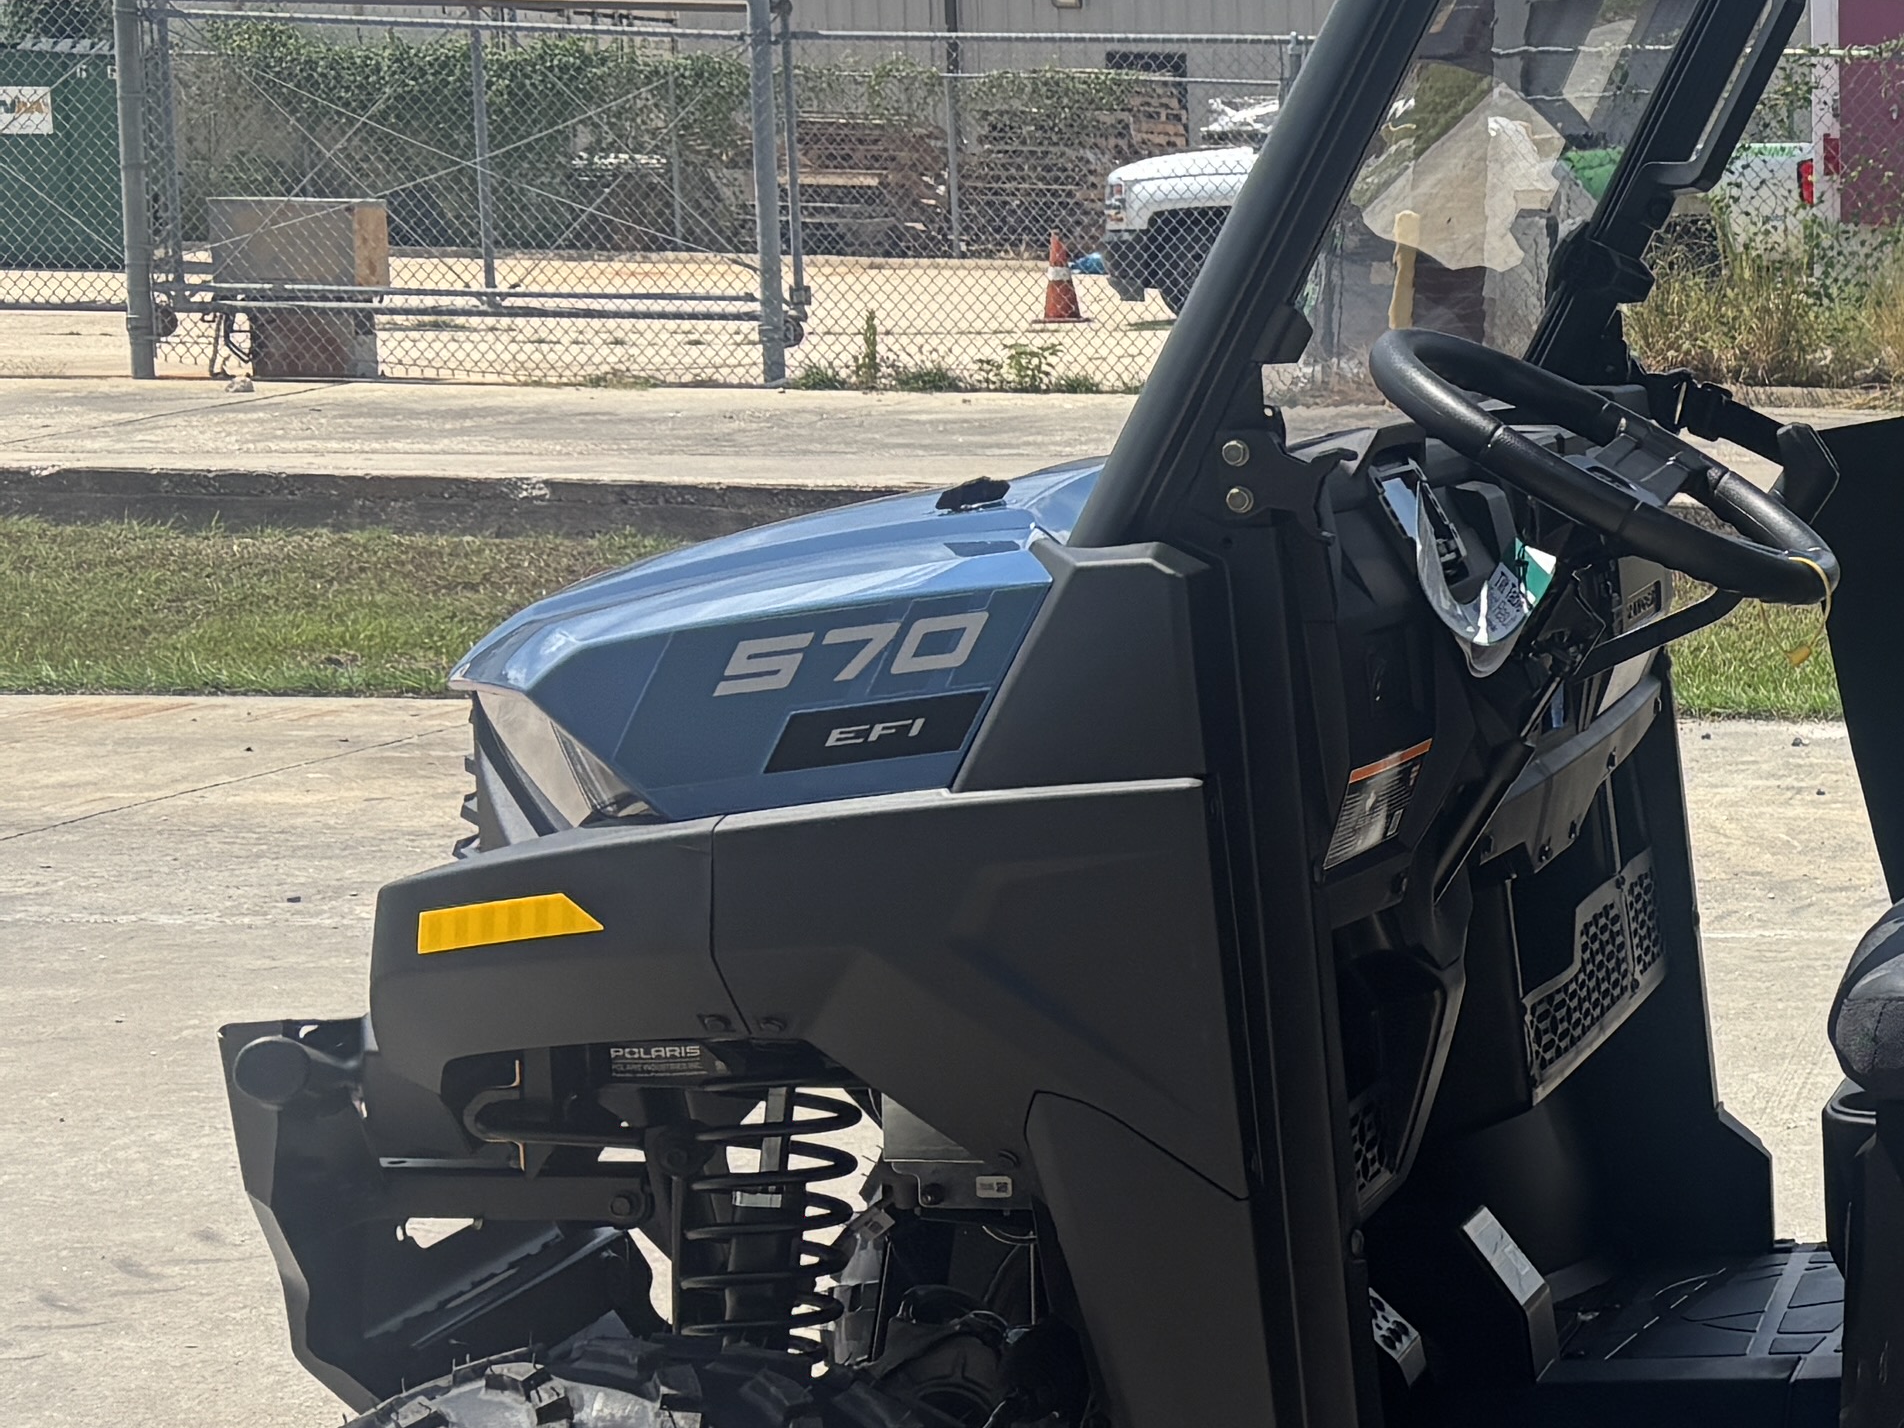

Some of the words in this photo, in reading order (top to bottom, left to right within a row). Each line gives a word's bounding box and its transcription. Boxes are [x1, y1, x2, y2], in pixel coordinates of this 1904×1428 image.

[712, 611, 989, 697] 570
[825, 718, 925, 747] EFI
[610, 1045, 701, 1059] POLARIS
